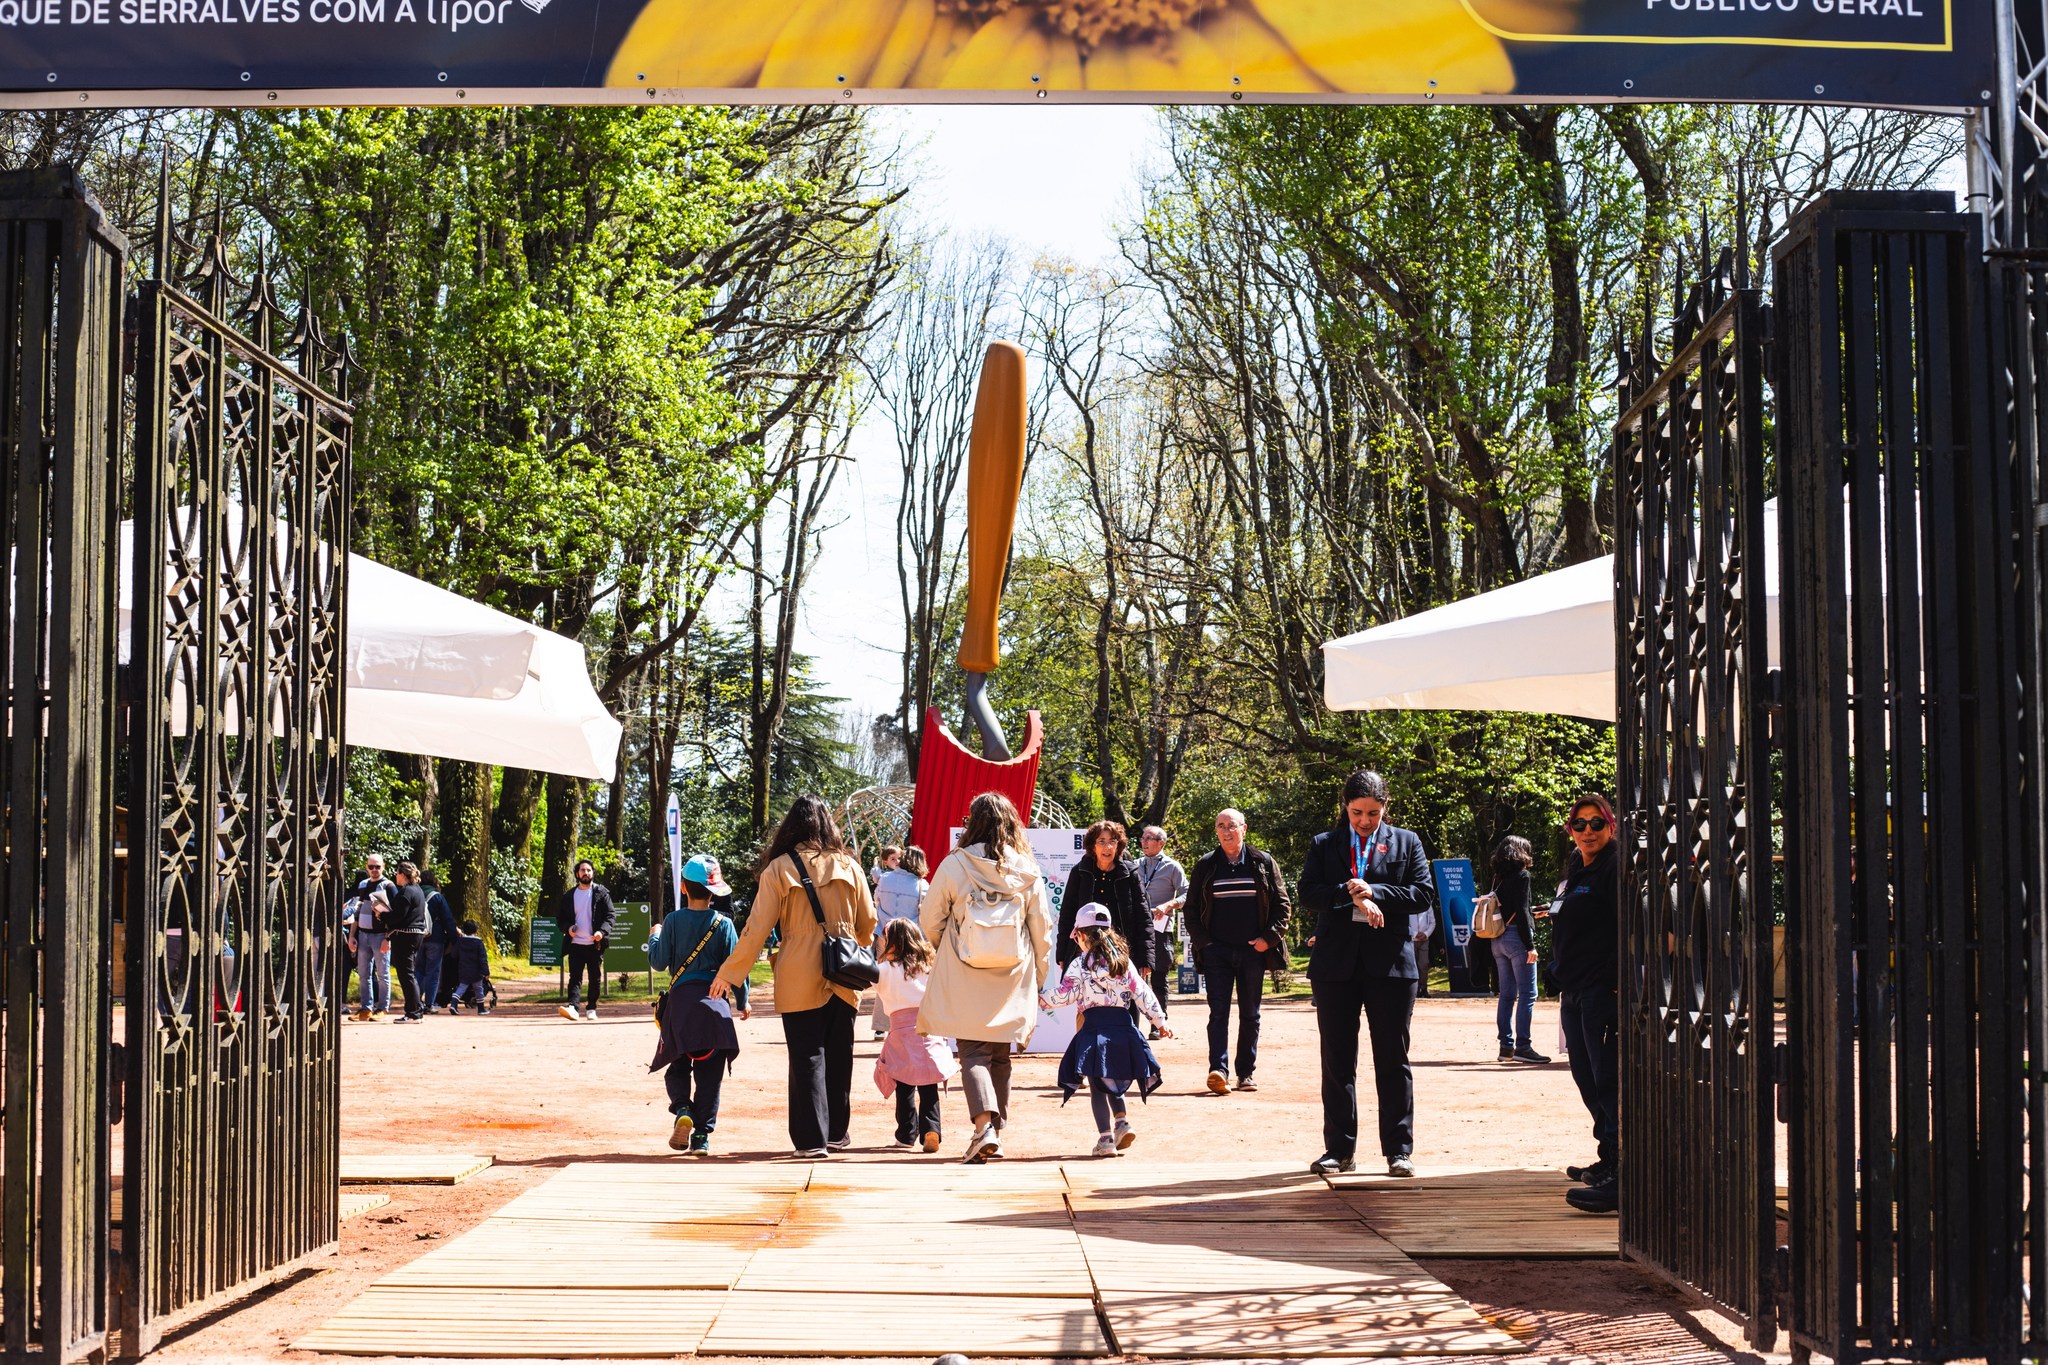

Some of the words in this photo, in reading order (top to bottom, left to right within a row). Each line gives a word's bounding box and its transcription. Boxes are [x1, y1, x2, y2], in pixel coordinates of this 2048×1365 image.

[71, 0, 110, 24] DE
[119, 0, 300, 24] SERRALVES
[309, 0, 385, 23] COM
[394, 0, 417, 23] A
[427, 0, 512, 32] lipor
[1812, 0, 1924, 17] GERAL
